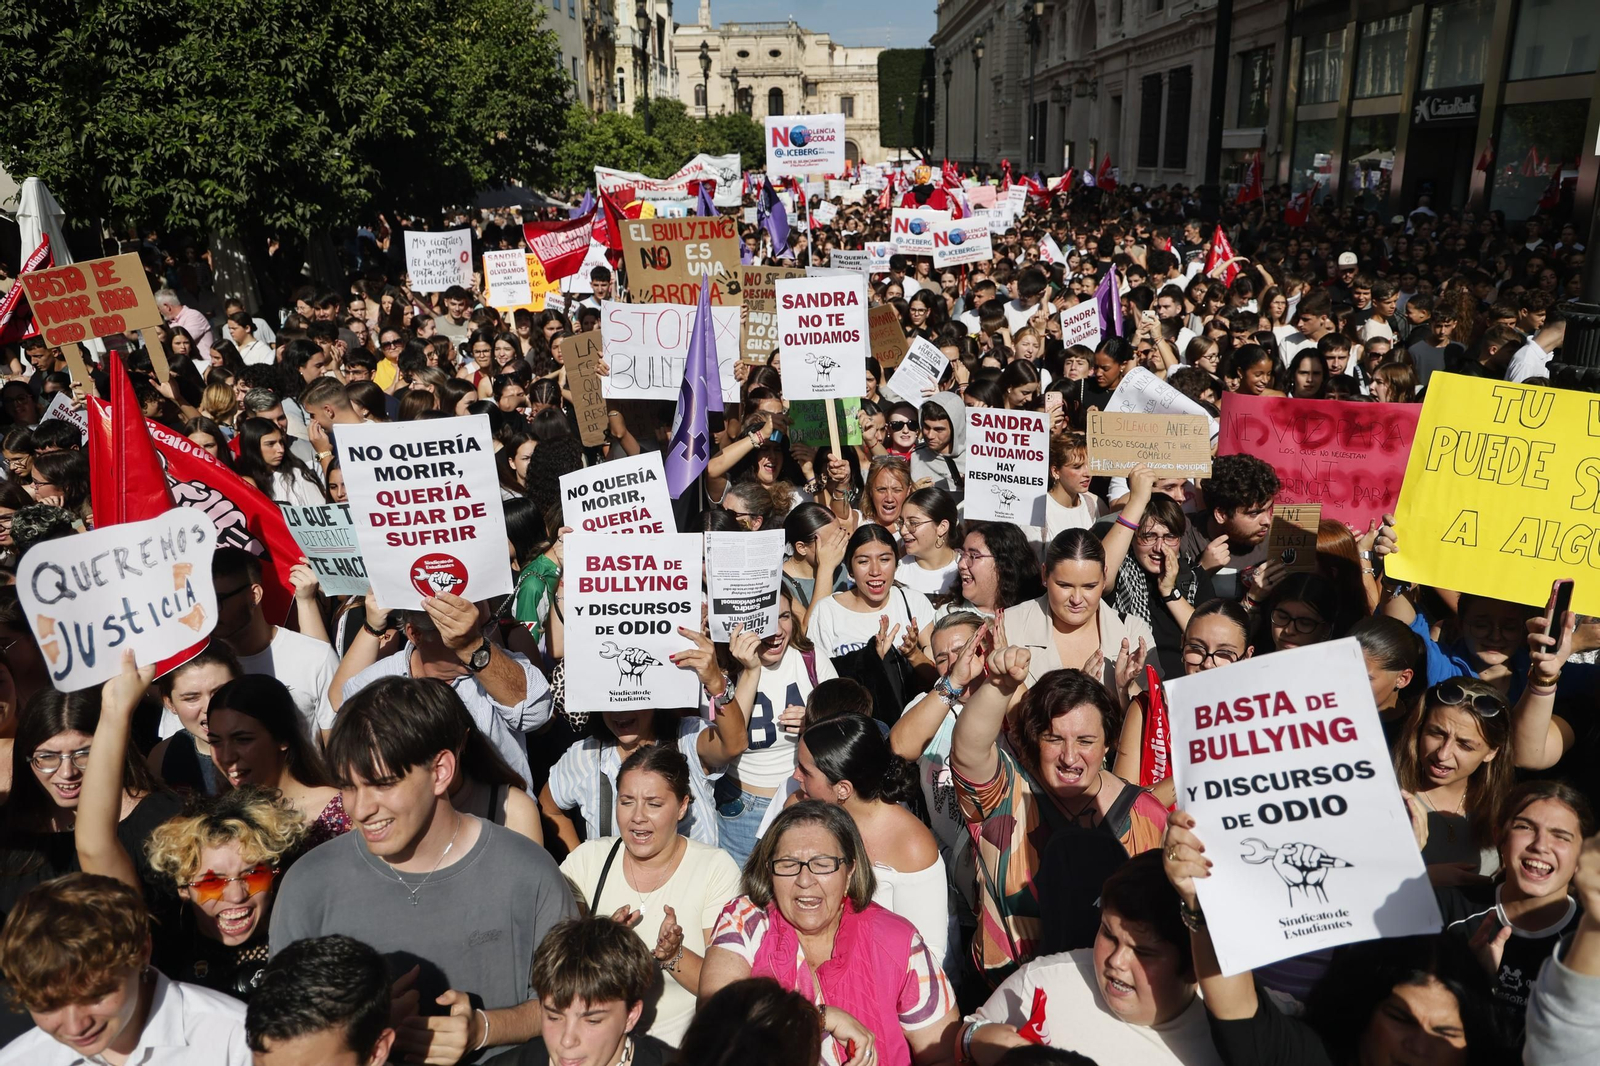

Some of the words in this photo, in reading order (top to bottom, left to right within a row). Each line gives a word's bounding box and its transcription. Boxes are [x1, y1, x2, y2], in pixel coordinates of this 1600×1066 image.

[786, 147, 818, 157] ICEBERG
[629, 223, 652, 241] EL
[652, 218, 736, 241] BULLYING
[487, 252, 523, 261] SANDRA
[640, 245, 672, 270] NO
[685, 242, 712, 260] ES
[489, 267, 525, 276] OLVIDAMOS
[687, 260, 725, 277] UNA
[744, 272, 761, 286] NO
[22, 266, 87, 302] BASTA
[90, 260, 121, 288] DE
[34, 295, 96, 326] MIRAR
[97, 286, 139, 314] PARA
[782, 290, 859, 310] SANDRA
[749, 311, 771, 326] NO
[798, 314, 822, 329] NO
[826, 313, 845, 327] TE
[1063, 307, 1097, 328] SANDRA
[1071, 325, 1083, 336] NO
[1083, 320, 1091, 331] TE
[46, 322, 86, 346] OTRO
[90, 314, 126, 338] LADO
[749, 324, 766, 337] LO
[784, 329, 860, 347] OLVIDAMOS
[1065, 328, 1098, 349] OLVIDAMOS
[574, 338, 603, 359] LA
[917, 345, 941, 367] HUELGA
[610, 353, 737, 391] BULLYIG
[1133, 374, 1153, 391] UNA
[58, 402, 82, 423] BASTA
[1492, 385, 1556, 429] TU
[970, 413, 1044, 433] SANDRA
[1092, 415, 1105, 435] EL
[1114, 418, 1159, 434] SILENCIO
[1166, 421, 1189, 436] ANTE
[1193, 426, 1205, 436] EL
[1226, 411, 1252, 442] NI
[1269, 415, 1325, 444] VOZ
[1336, 419, 1405, 448] PARA
[348, 445, 383, 462] NO
[389, 433, 482, 462] QUERÍA
[985, 431, 1008, 444] NO
[1012, 434, 1030, 447] TE
[1092, 437, 1123, 448] ACOSO
[1126, 440, 1160, 452] ESCOLAR
[1164, 441, 1176, 449] TE
[971, 444, 1044, 462] OLVIDAMOS
[1279, 447, 1295, 455] LOS
[1299, 448, 1317, 457] QUE
[1331, 450, 1367, 460] NECESITAN
[1425, 426, 1556, 490] PUEDE
[374, 461, 464, 483] MORIR,
[996, 463, 1015, 472] HAY
[1301, 458, 1339, 483] NI
[566, 484, 589, 501] NO
[592, 467, 658, 493] QUERÍA
[968, 471, 1044, 487] RESPONSABLES
[376, 481, 472, 509] QUERÍA
[581, 489, 646, 513] MORIR,
[1353, 484, 1392, 502] PARA
[283, 506, 302, 527] LO
[302, 505, 337, 527] QUE
[369, 508, 447, 527] DEJAR
[453, 502, 487, 522] DE
[582, 506, 652, 533] QUERÍA
[386, 525, 477, 548] SUFRIR
[1442, 510, 1478, 547] A
[31, 523, 206, 605] QUEREMOS
[308, 556, 338, 576] TE
[586, 554, 658, 572] BASTA
[663, 559, 683, 571] DE
[578, 574, 689, 594] BULLYING
[575, 605, 585, 616] Y
[588, 601, 692, 617] DISCURSOS
[595, 625, 615, 636] DE
[618, 620, 672, 636] ODIO
[609, 689, 642, 697] Sindicato
[609, 695, 651, 703] Estudiantes
[1194, 690, 1296, 730] BASTA
[1305, 691, 1339, 713] DE
[1188, 716, 1359, 765] BULLYING
[1186, 785, 1199, 803] Y
[1204, 760, 1376, 801] DISCURSOS
[1221, 813, 1255, 831] DE
[1257, 794, 1348, 826] ODIO
[1278, 910, 1333, 929] Sindicato
[1334, 908, 1350, 919] de
[1283, 918, 1353, 940] Estudiantes
